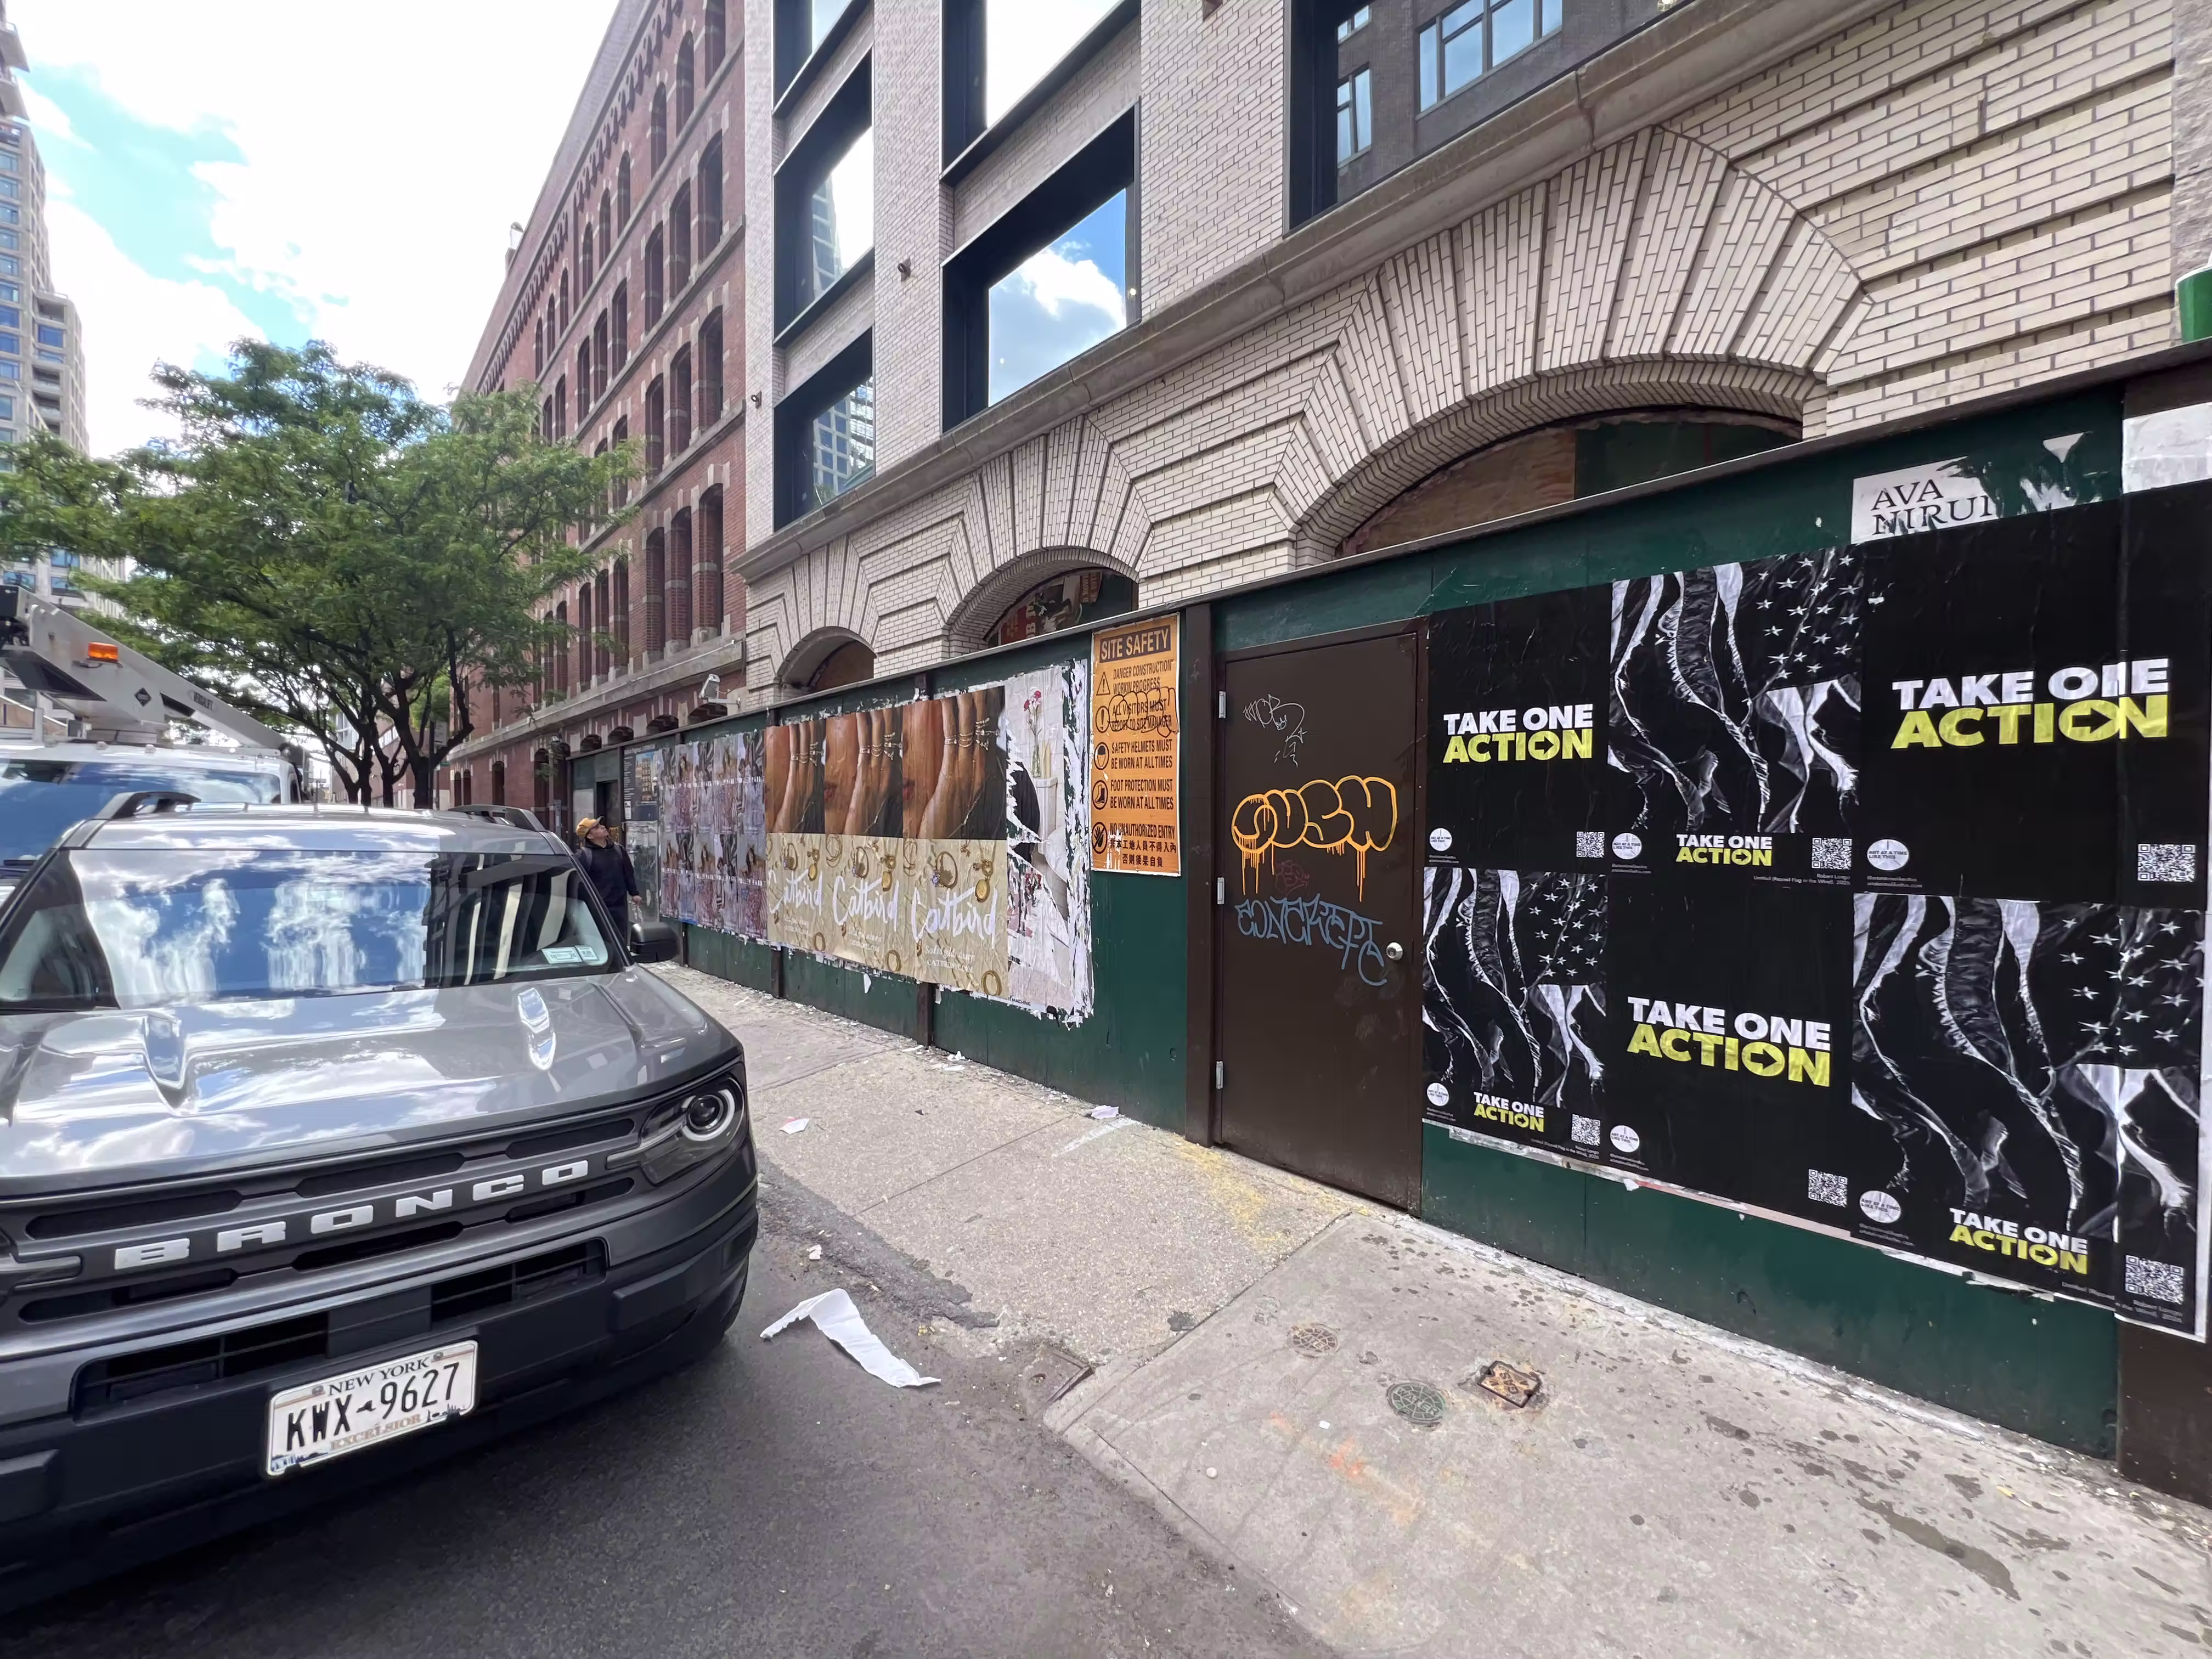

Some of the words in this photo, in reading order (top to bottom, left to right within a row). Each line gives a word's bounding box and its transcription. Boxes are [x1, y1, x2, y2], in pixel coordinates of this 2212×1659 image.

[1871, 479, 1944, 511] AVA
[1871, 495, 1993, 535] NIRUI
[1101, 637, 1123, 660] SITE
[1126, 629, 1169, 656] SAFETY
[1113, 667, 1132, 680] DANGER
[1132, 659, 1172, 676] CONSTRUCTION
[1133, 676, 1160, 692] PROGRESS
[1892, 670, 2034, 710] TAKE
[1113, 704, 1122, 716] ALL
[1122, 702, 1148, 715] VISITORS
[1149, 698, 1167, 713] MUST
[1130, 719, 1136, 730] TO
[1136, 718, 1147, 730] SITE
[1147, 715, 1172, 729] MANAGER
[1443, 709, 1516, 736] TAKE
[1522, 703, 1593, 731] ONE
[1890, 694, 2168, 749] ACTION
[1111, 741, 1130, 754] SAFETY
[1131, 740, 1155, 753] HELMETS
[1156, 738, 1172, 752] MUST
[1443, 728, 1593, 764] ACTION
[1111, 758, 1118, 770] BE
[1119, 757, 1135, 769] WORN
[1136, 757, 1143, 769] AT
[1144, 756, 1155, 769] ALL
[1155, 755, 1172, 768] TIMES
[1110, 779, 1124, 792] FOOT
[1125, 778, 1156, 792] PROTECTION
[1158, 778, 1173, 792] MUST
[1110, 796, 1118, 809] BE
[1118, 796, 1135, 809] WORN
[1136, 797, 1143, 809] AT
[1144, 796, 1155, 809] ALL
[1155, 796, 1174, 810] TIMES
[1110, 822, 1118, 835] NO
[1118, 823, 1157, 838] UNAUTHORIZED
[1158, 825, 1175, 839] ENTRY
[1676, 834, 1724, 848] TAKE
[1728, 835, 1773, 850] ONE
[1675, 847, 1772, 866] ACTION
[769, 868, 823, 917] Catbird
[832, 874, 900, 932] Catbird
[911, 885, 999, 950] Catbird
[1627, 996, 1725, 1035] TAKE
[1734, 1012, 1831, 1051] ONE
[1627, 1023, 1830, 1087] ACTION
[1474, 1091, 1509, 1110] TAKE
[1511, 1101, 1544, 1119] ONE
[1474, 1103, 1544, 1132] ACTION
[114, 1160, 589, 1269] BRONCO
[1949, 1207, 2019, 1238] TAKE
[2024, 1226, 2088, 1255] ONE
[1949, 1224, 2087, 1274] ACTION
[328, 1372, 376, 1397] NEW
[379, 1356, 431, 1380] YORK
[286, 1393, 353, 1452] KWX
[380, 1361, 460, 1420] 9627
[1393, 1386, 1440, 1417] WATER
[330, 1413, 422, 1451] EXCELSIOR
